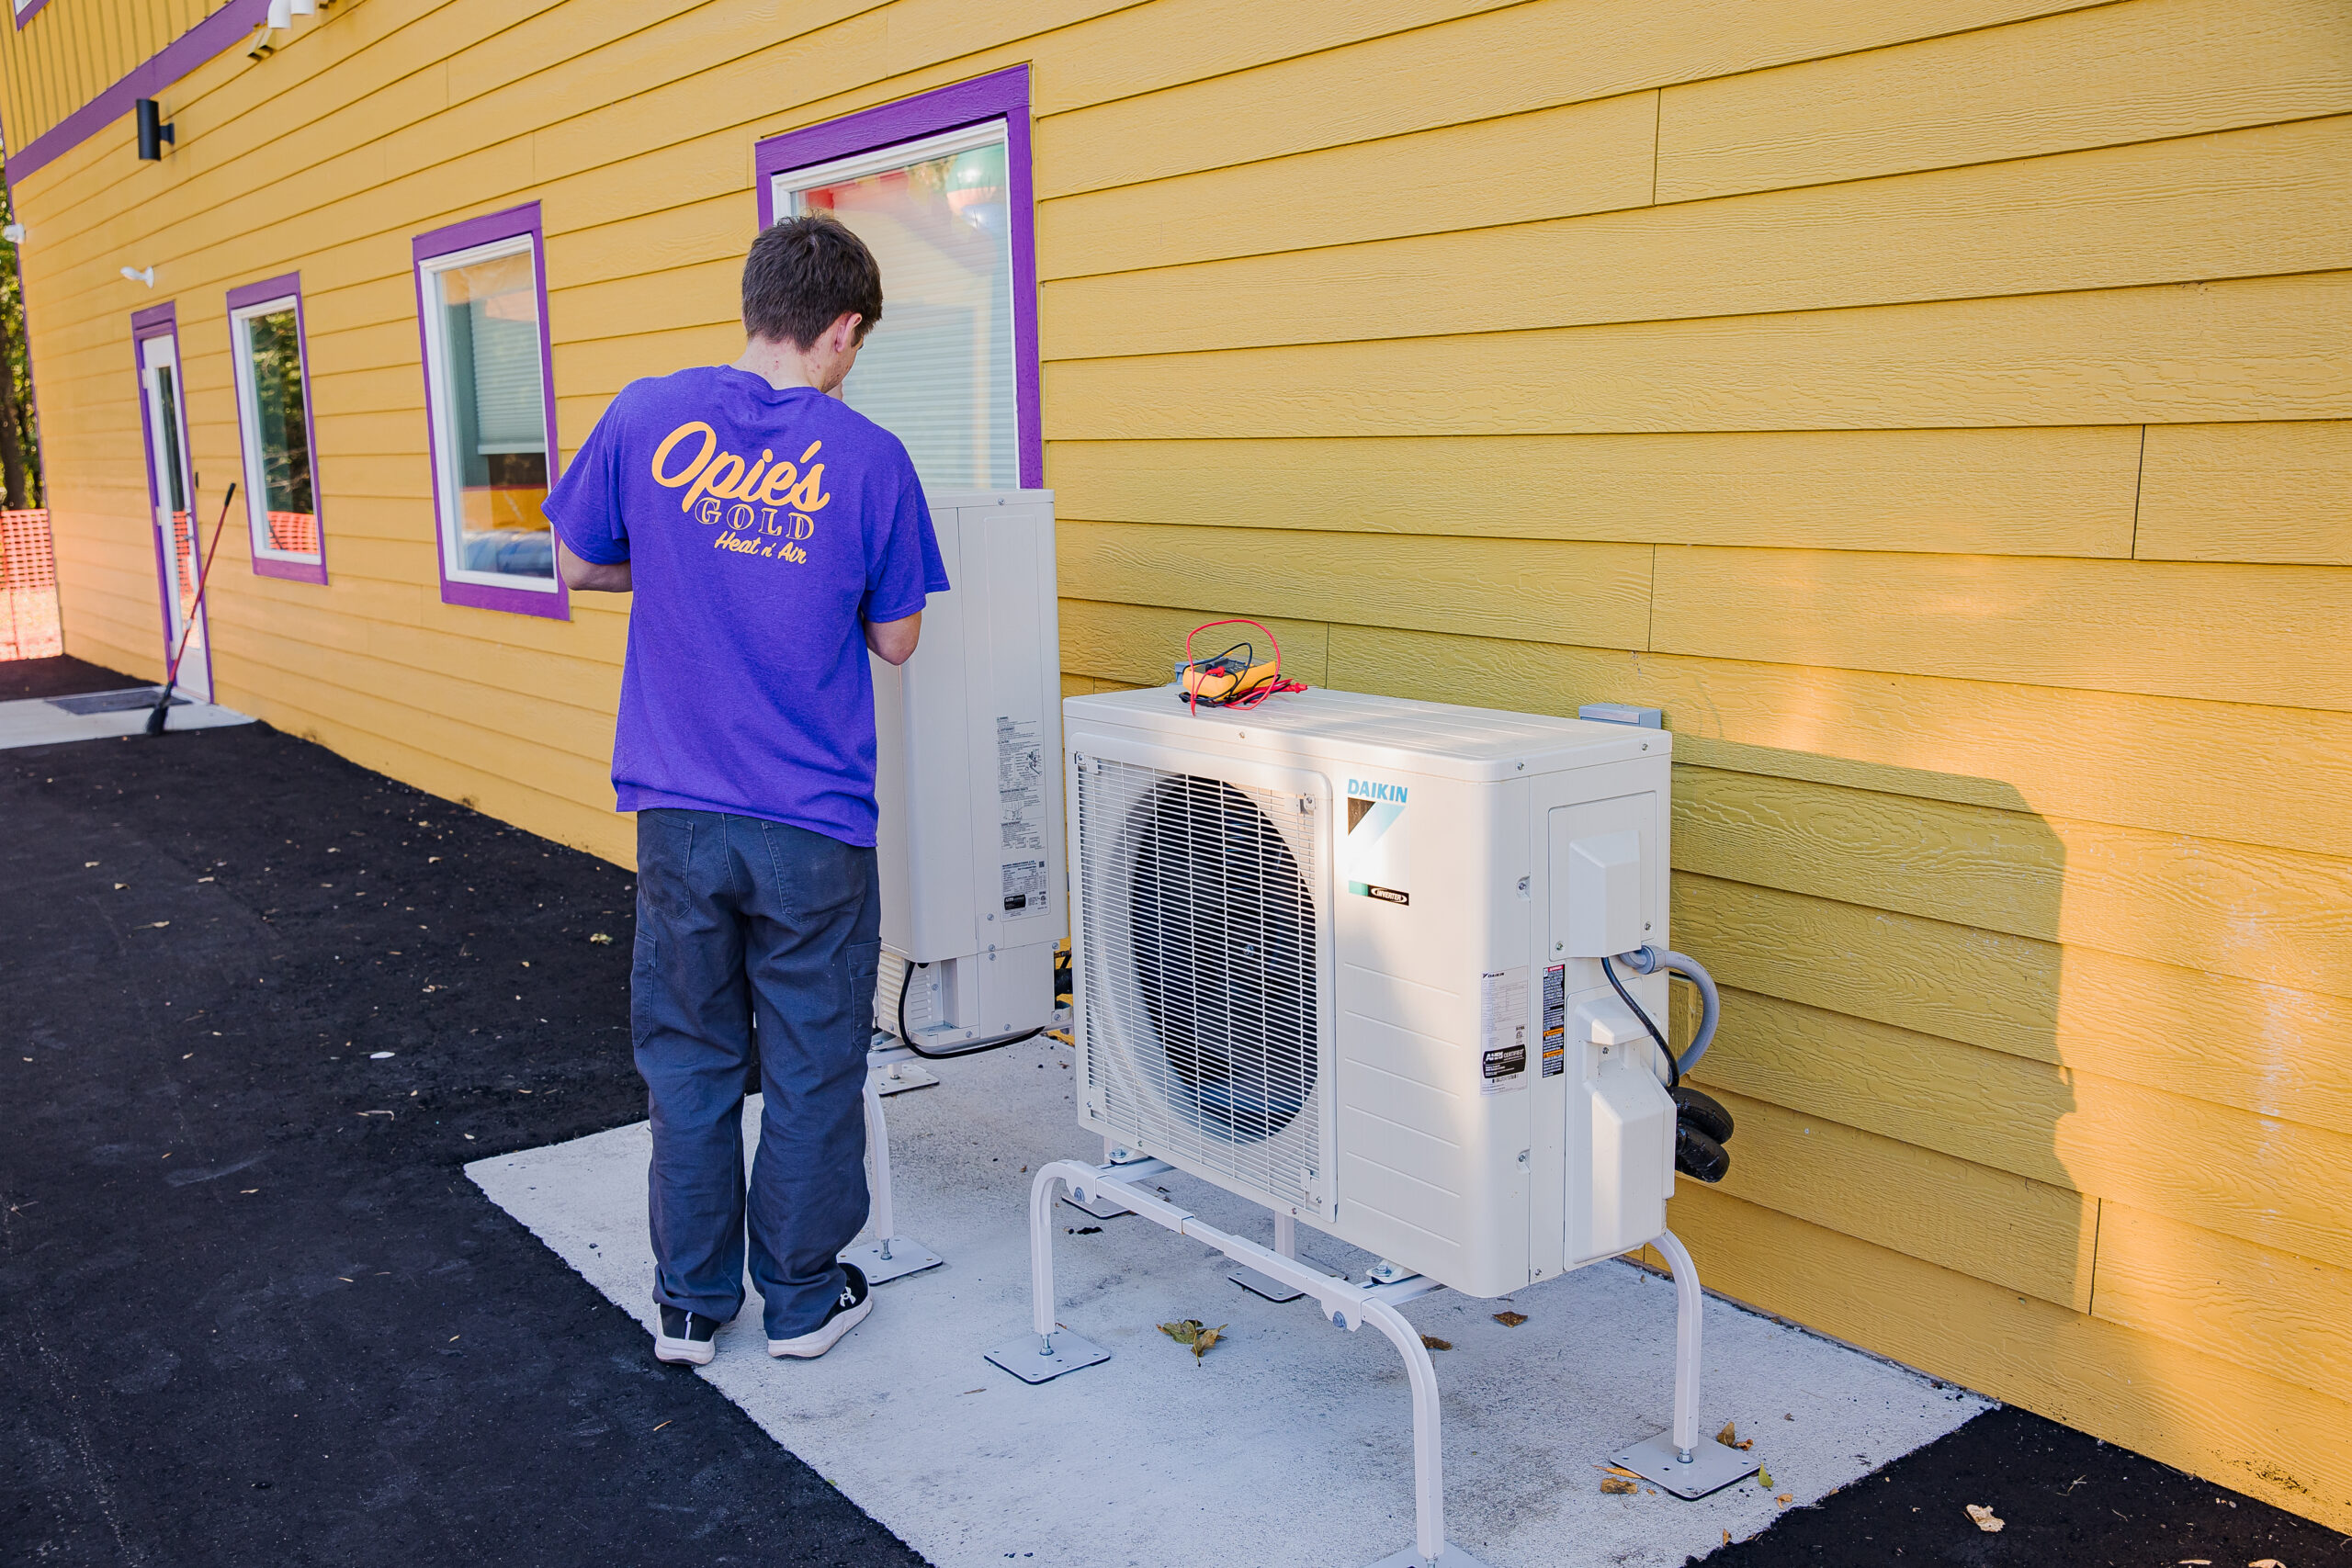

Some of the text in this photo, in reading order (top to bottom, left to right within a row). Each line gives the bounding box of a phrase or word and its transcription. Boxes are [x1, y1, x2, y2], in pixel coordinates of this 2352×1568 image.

[651, 421, 831, 513] Opie's
[695, 497, 814, 540] GOLD
[714, 530, 762, 555] Heat
[777, 541, 807, 565] Air
[1347, 779, 1408, 803] DAIKIN
